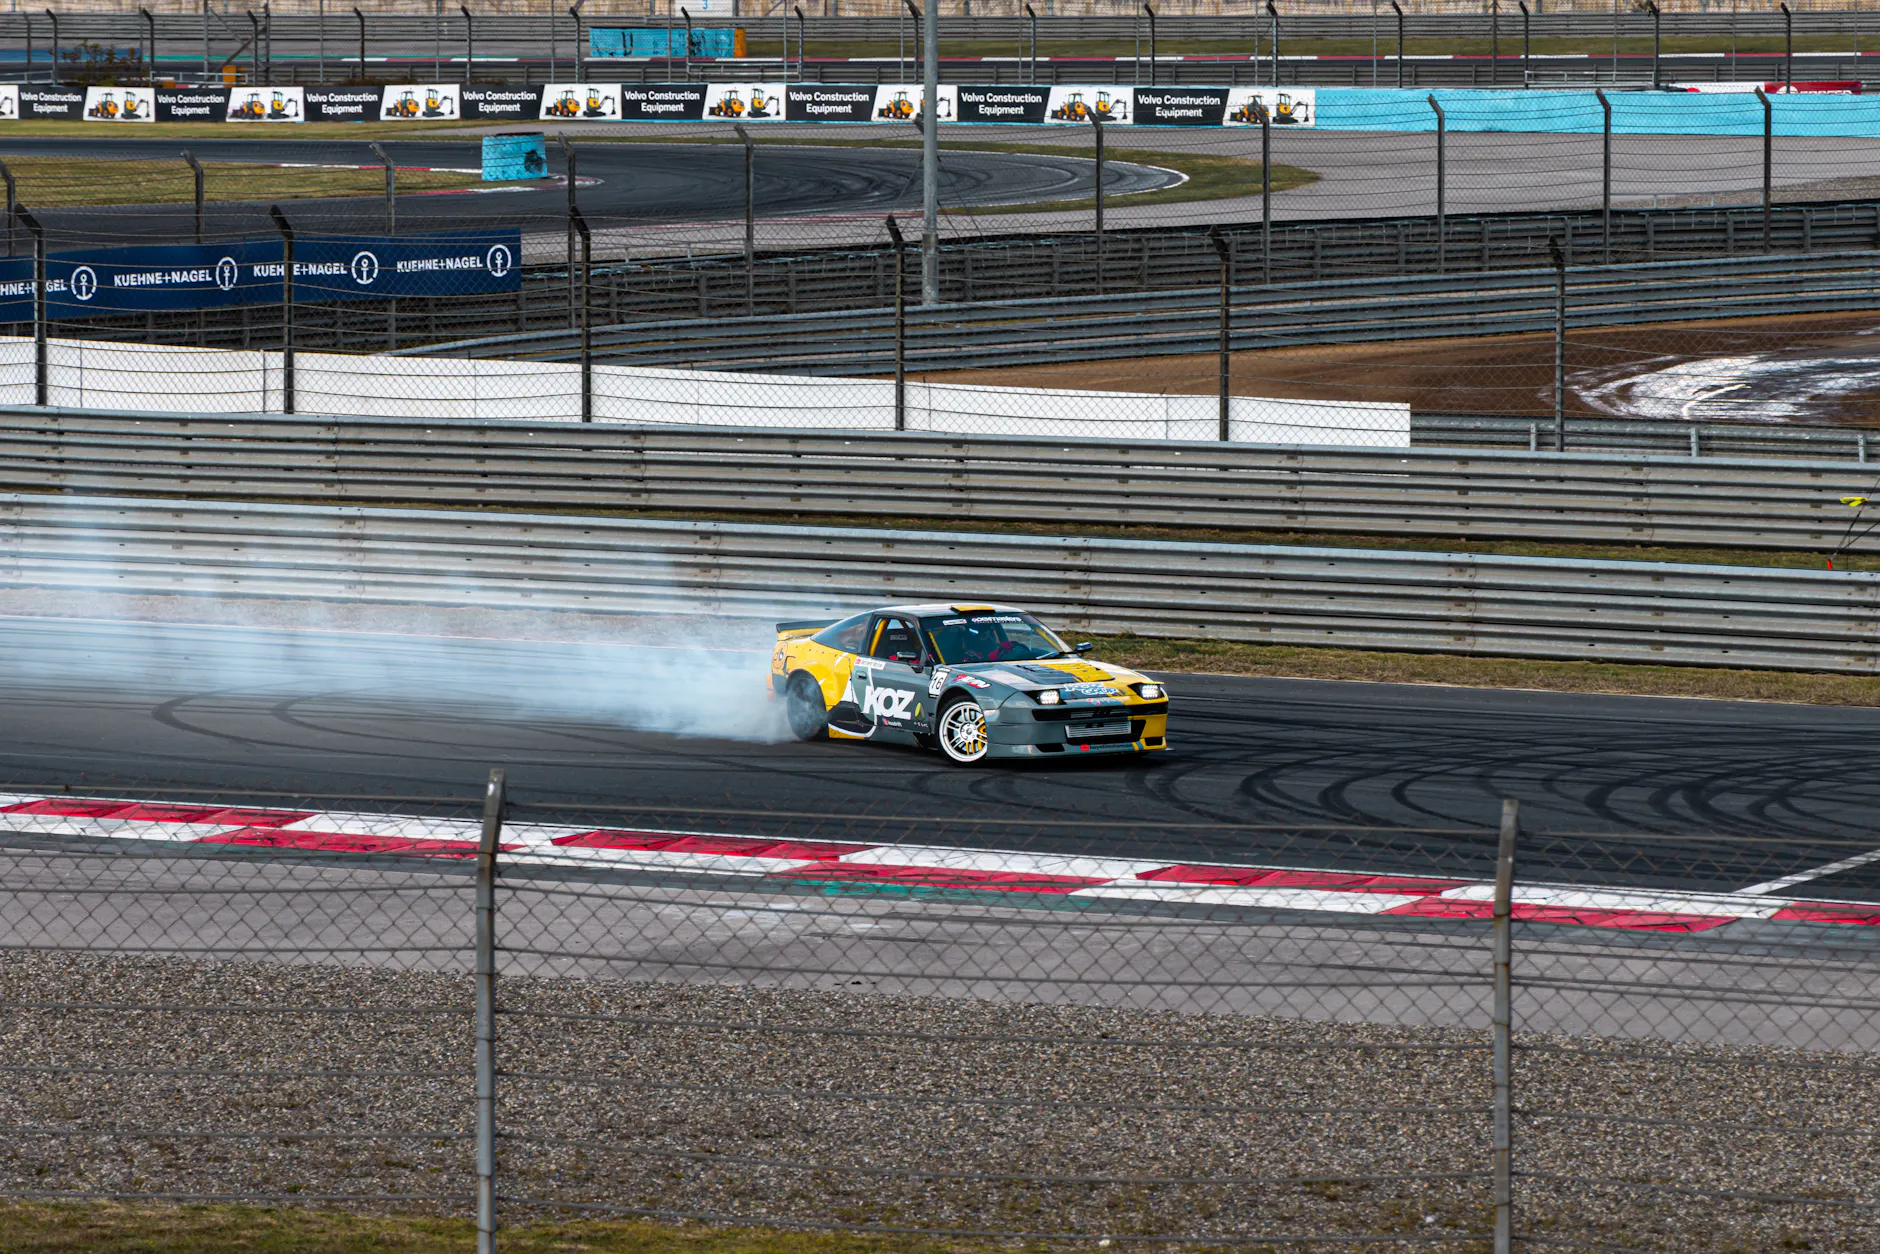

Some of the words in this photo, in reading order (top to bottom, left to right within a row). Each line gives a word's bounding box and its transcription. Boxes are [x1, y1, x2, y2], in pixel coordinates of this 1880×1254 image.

[21, 92, 38, 101] Volvo
[38, 92, 82, 102] Construction
[157, 94, 176, 103] Volvo
[177, 94, 225, 104] Construction
[307, 93, 328, 102] Volvo
[329, 93, 378, 102] Construction
[463, 91, 484, 100] Volvo
[486, 91, 537, 100] Construction
[624, 91, 647, 100] Volvo
[648, 91, 700, 100] Construction
[789, 91, 812, 101] Volvo
[814, 91, 870, 102] Construction
[961, 92, 985, 102] Volvo
[986, 93, 1042, 103] Construction
[1138, 94, 1162, 104] Volvo
[1163, 95, 1221, 105] Construction
[33, 102, 69, 113] Equipment
[171, 105, 210, 116] Equipment
[321, 104, 363, 115] Equipment
[478, 102, 520, 113] Equipment
[641, 102, 685, 113] Equipment
[806, 103, 852, 114] Equipment
[978, 104, 1024, 115] Equipment
[1155, 106, 1203, 118] Equipment
[253, 262, 348, 277] KUEHE+NAGEL
[396, 256, 484, 273] KUEHNE+NAGEL
[113, 269, 213, 287] KUEHNE+NAGEL
[931, 675, 945, 691] 16
[861, 685, 915, 720] KOZ
